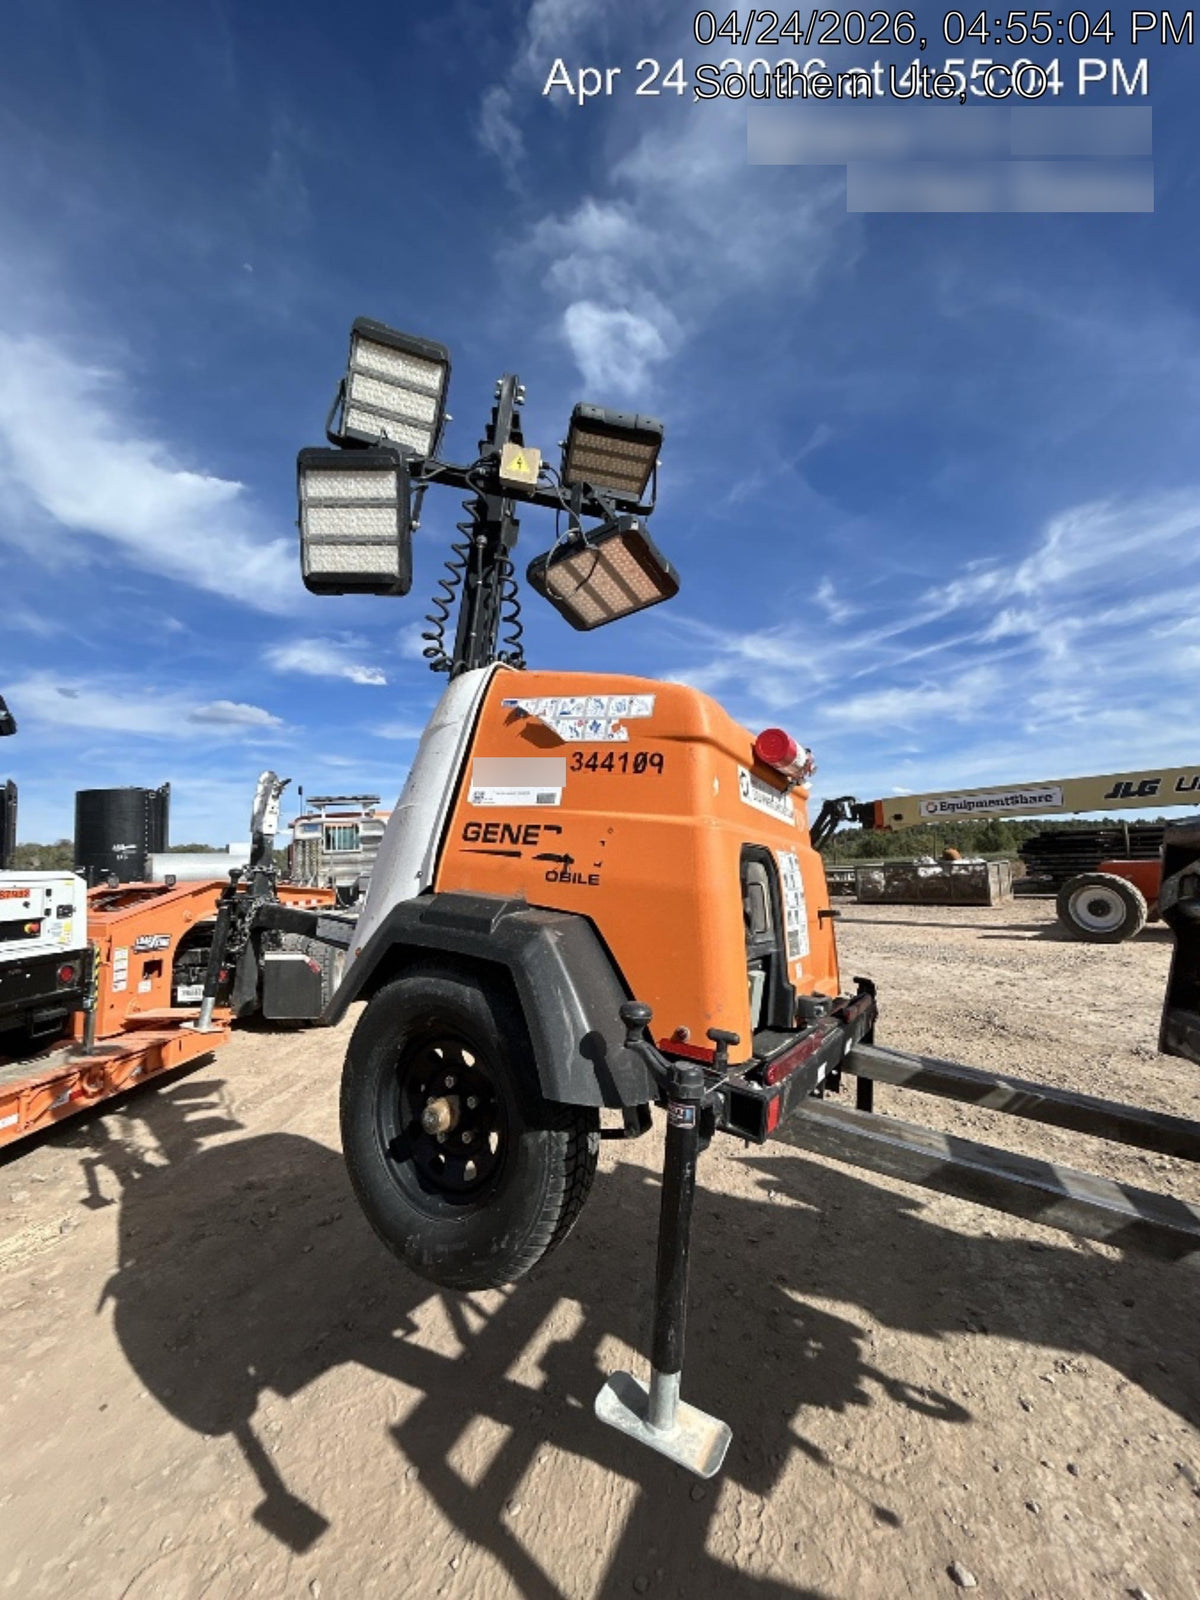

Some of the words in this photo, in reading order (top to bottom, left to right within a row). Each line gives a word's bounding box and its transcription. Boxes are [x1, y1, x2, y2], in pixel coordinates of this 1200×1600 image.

[570, 751, 664, 774] 344109
[1104, 779, 1161, 798] JLG
[940, 794, 1053, 812] EquipmentShare
[462, 822, 562, 845] GENE
